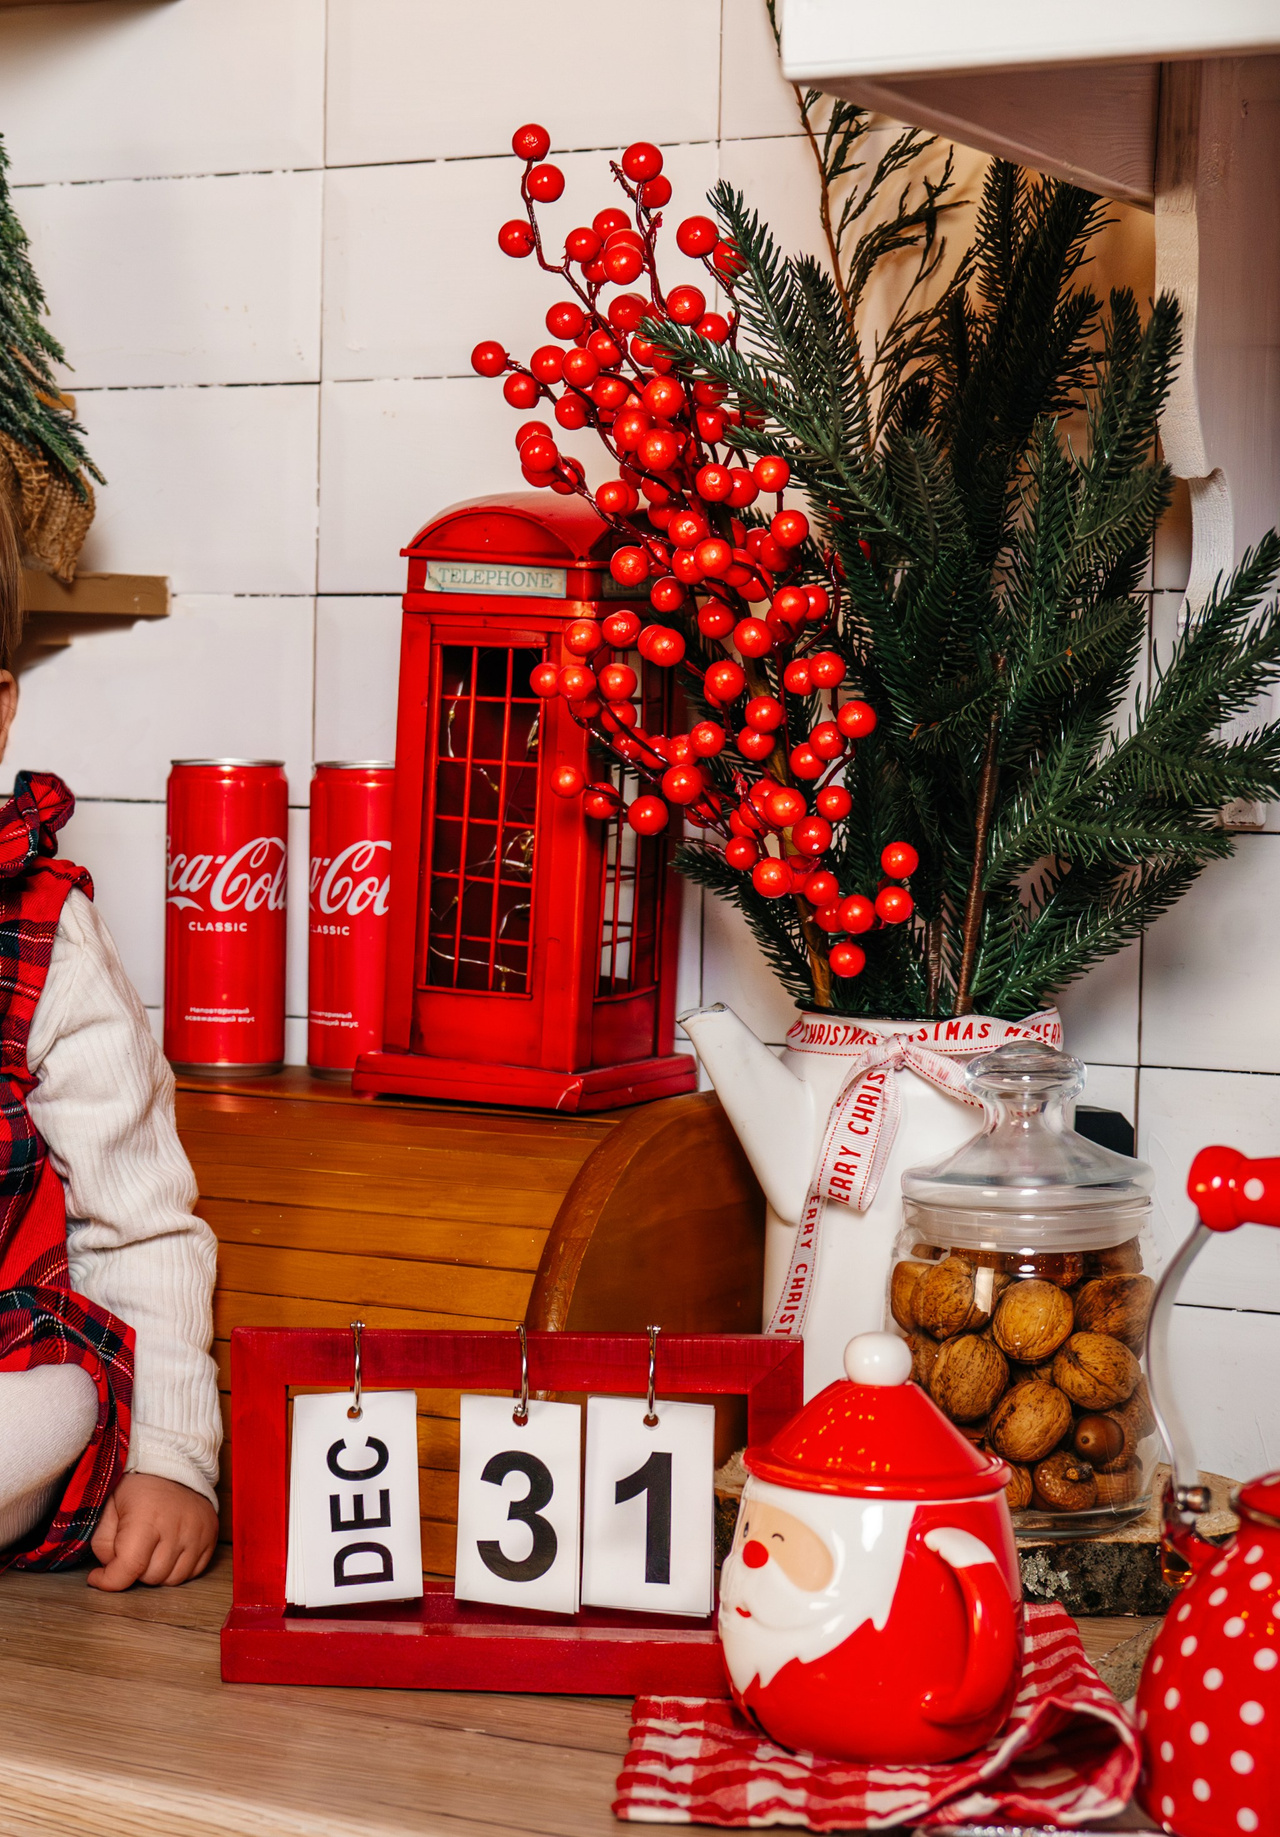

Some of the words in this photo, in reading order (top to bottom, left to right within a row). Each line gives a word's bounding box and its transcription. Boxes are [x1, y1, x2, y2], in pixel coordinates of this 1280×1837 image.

[438, 567, 553, 589] TELEPHONE
[188, 921, 248, 932] CLASSIC
[828, 1145, 862, 1206] ERRY
[847, 1071, 886, 1136] CHRIS
[801, 1194, 821, 1250] ERRY
[775, 1262, 808, 1335] CHRIST
[326, 1435, 394, 1588] DEC
[476, 1449, 558, 1583] 3
[614, 1451, 673, 1585] 1
